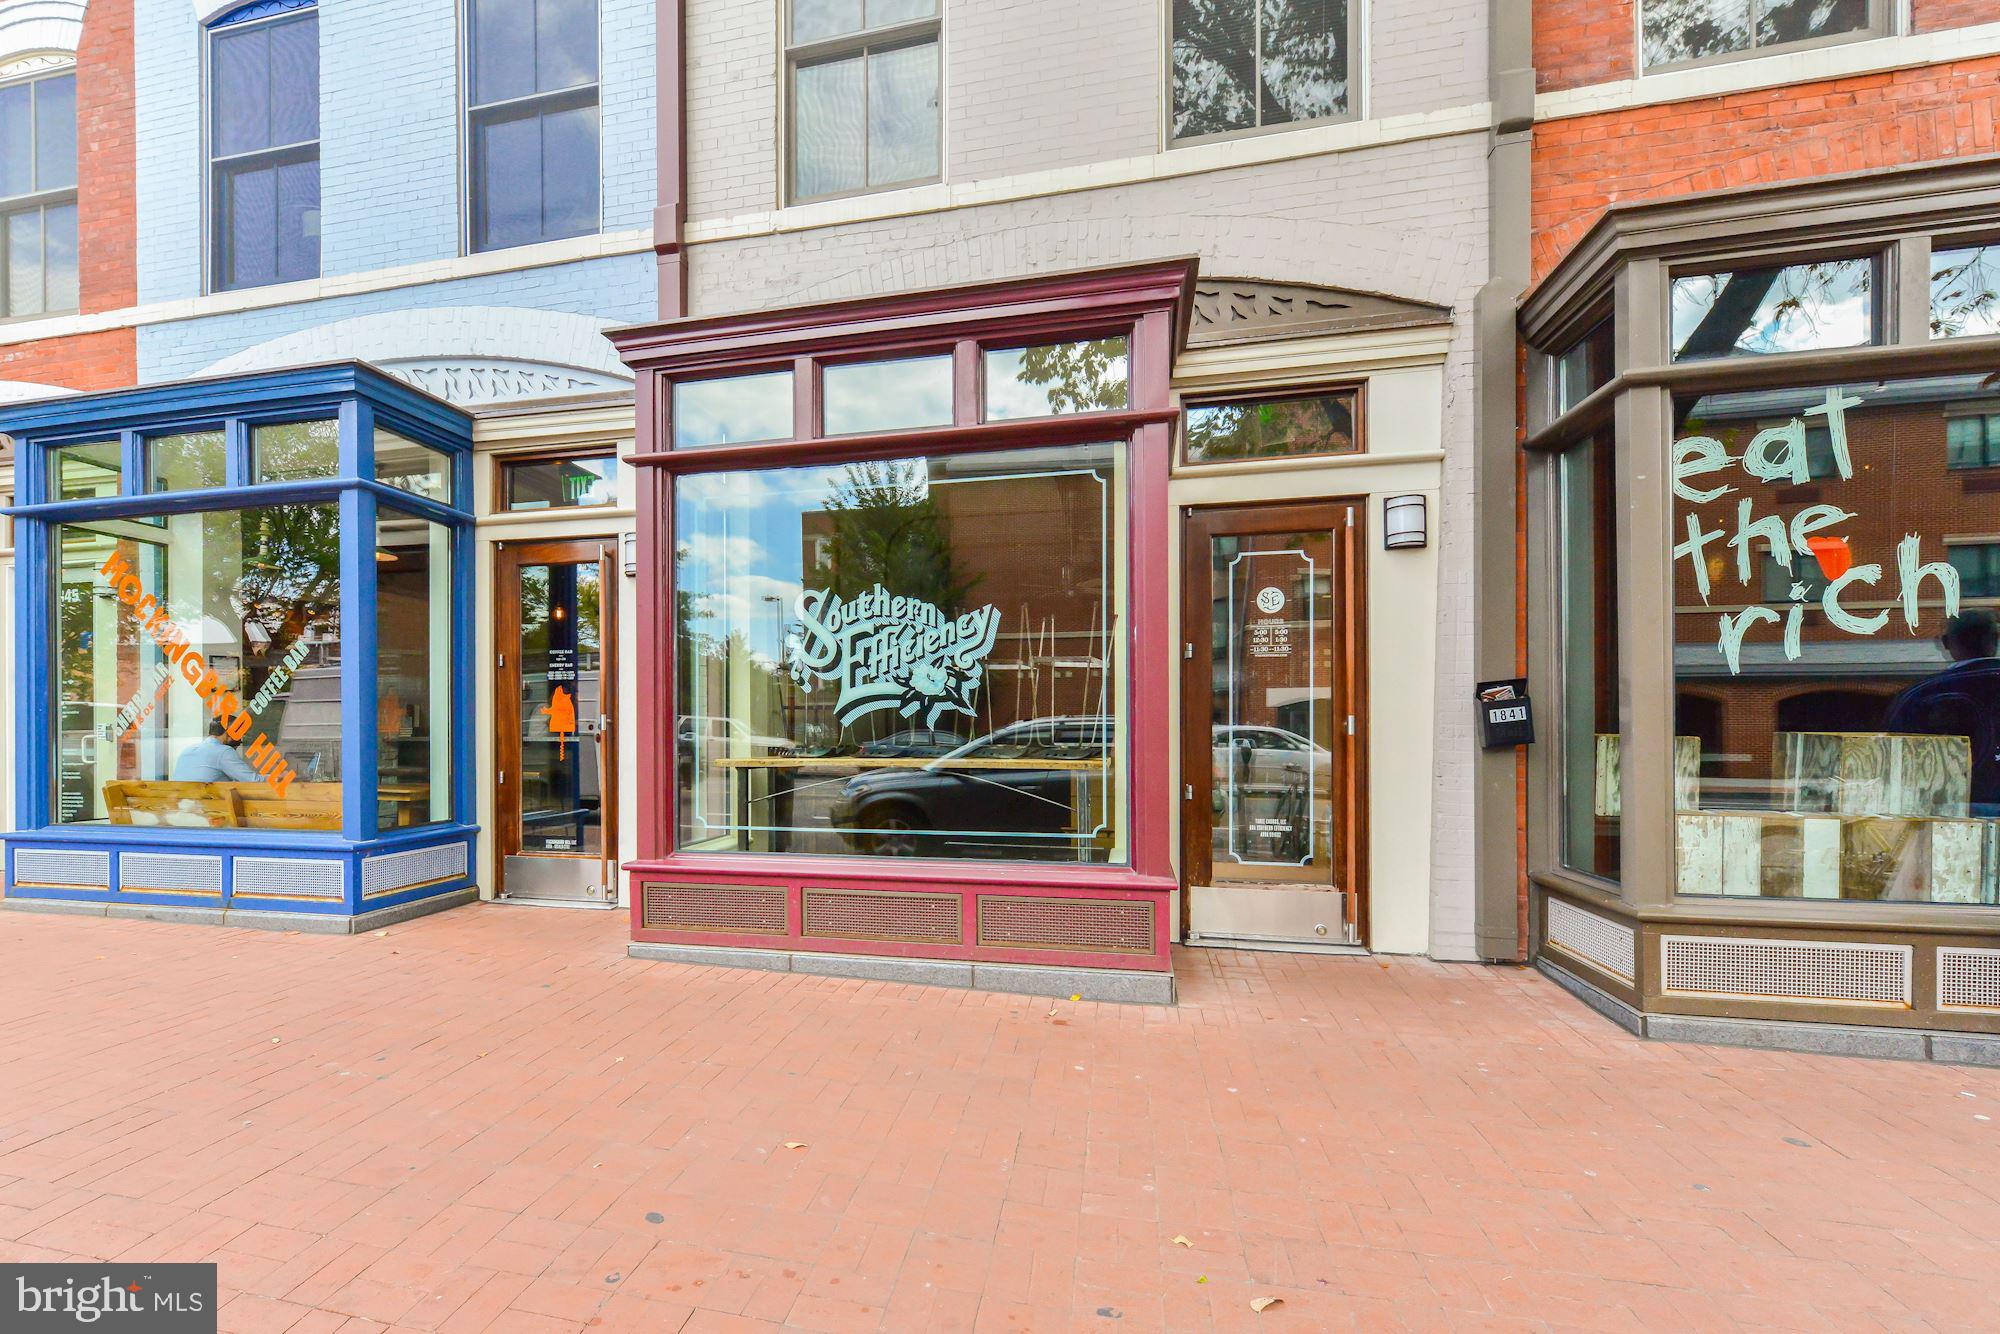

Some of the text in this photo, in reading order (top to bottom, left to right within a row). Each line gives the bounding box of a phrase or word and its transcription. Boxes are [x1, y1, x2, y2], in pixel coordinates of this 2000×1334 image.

[1673, 387, 1864, 503] eat
[1674, 497, 1858, 607] the
[1719, 531, 1960, 676] rich
[100, 551, 297, 798] MOCKINGBIRD HILL
[249, 640, 310, 715] COFFEE BAR
[794, 582, 940, 668] Southern
[833, 604, 996, 720] Efficiency
[1493, 708, 1524, 722] 1841
